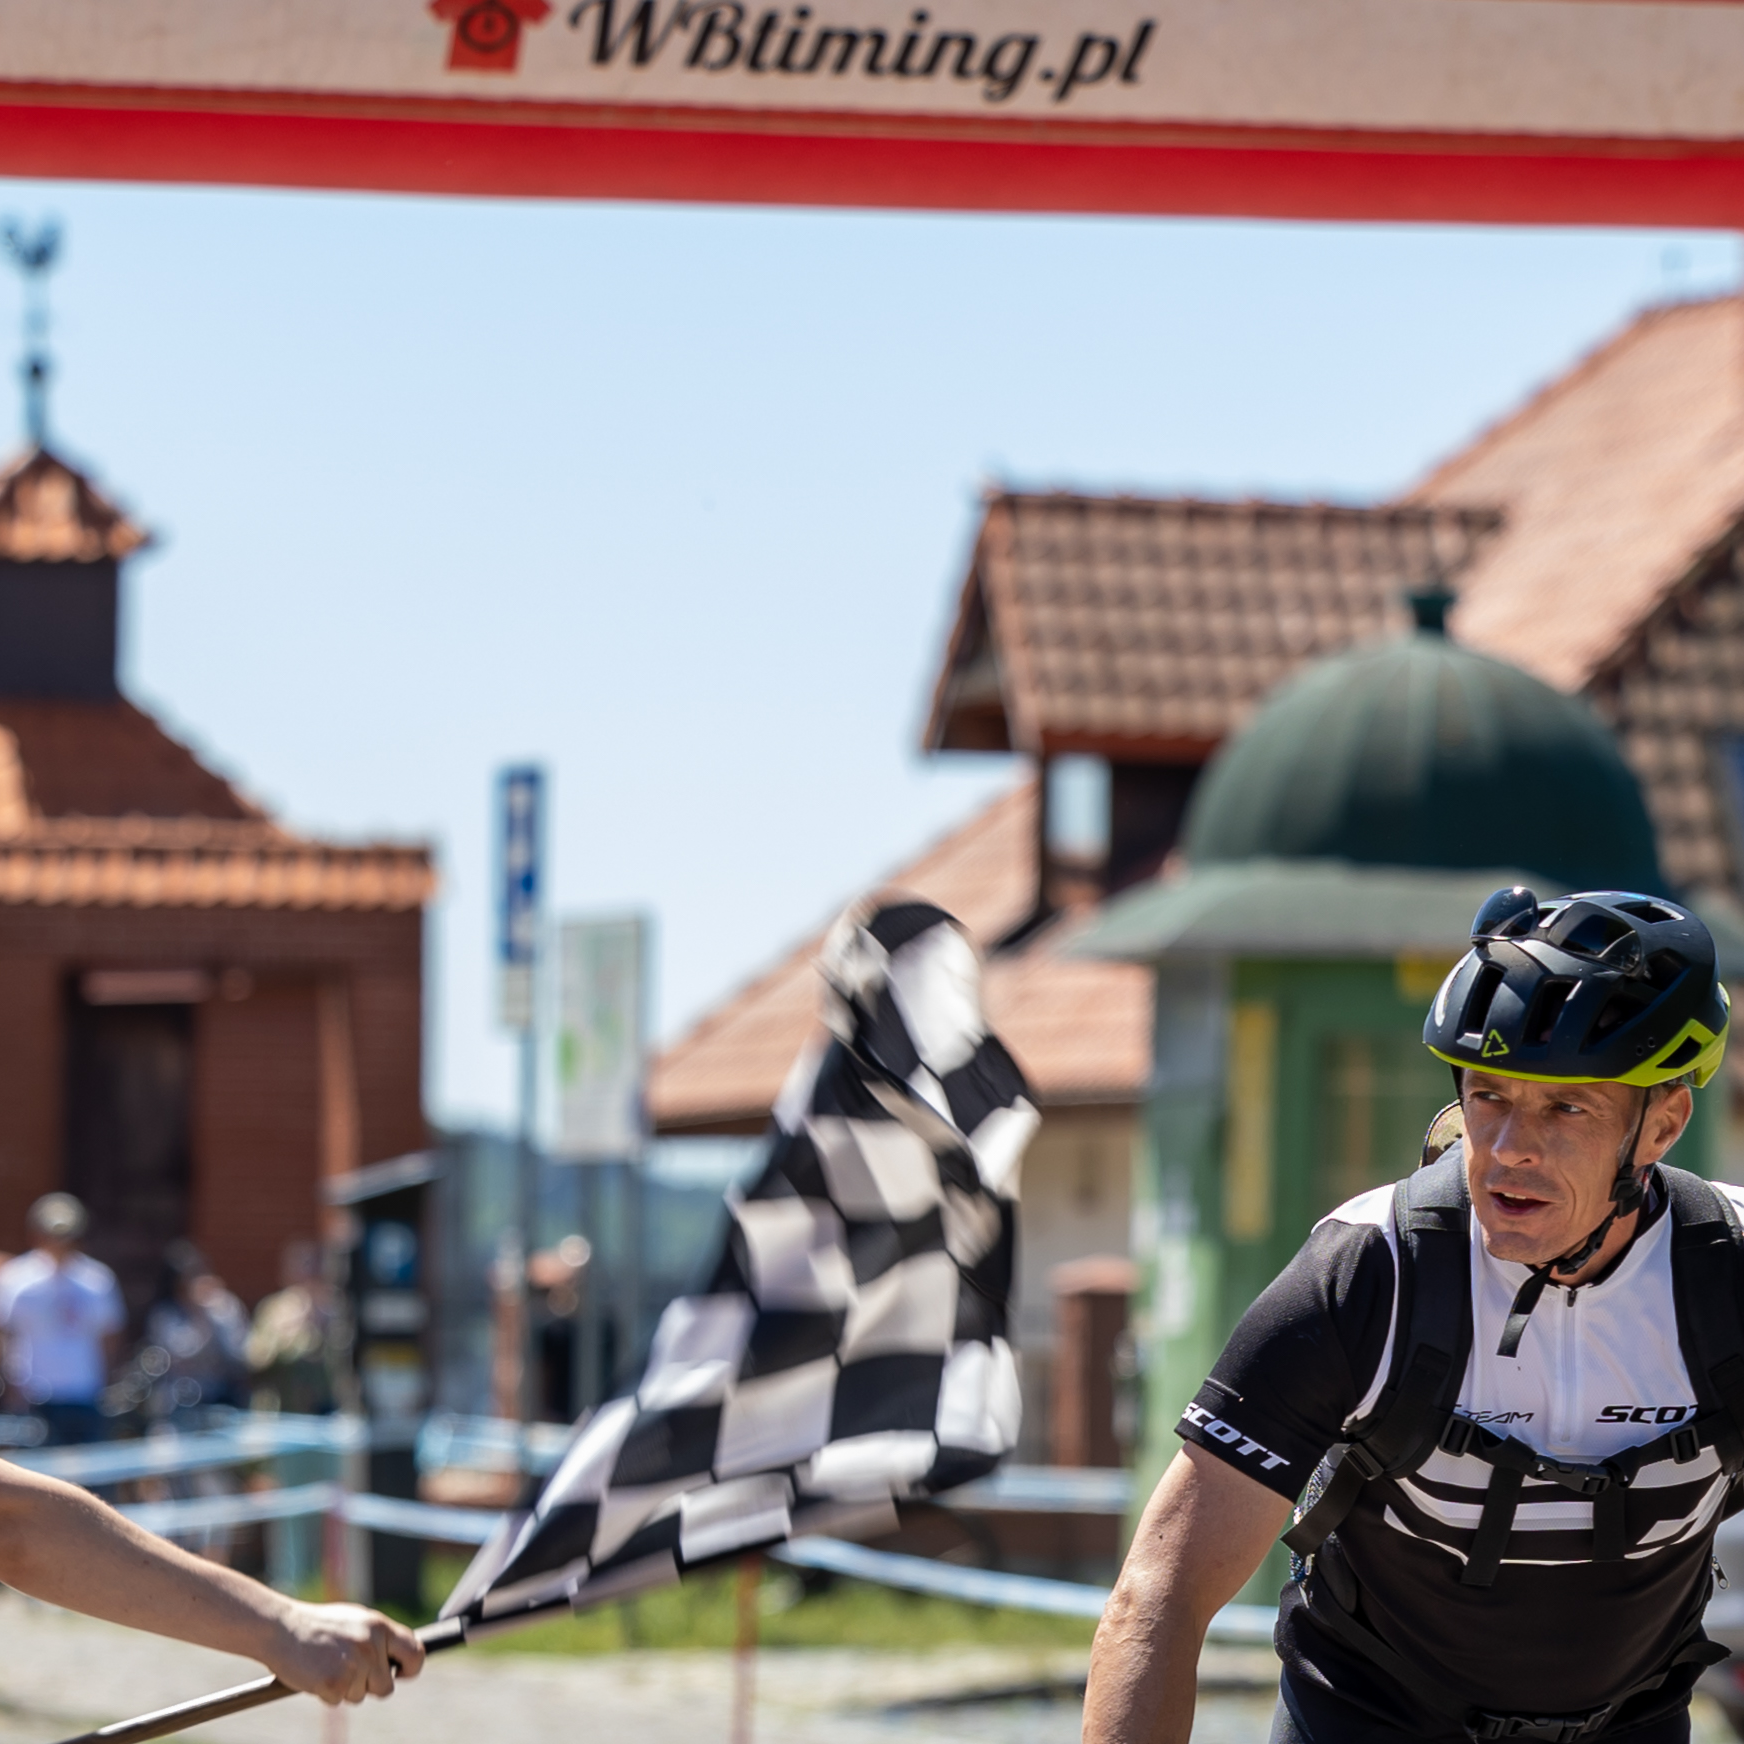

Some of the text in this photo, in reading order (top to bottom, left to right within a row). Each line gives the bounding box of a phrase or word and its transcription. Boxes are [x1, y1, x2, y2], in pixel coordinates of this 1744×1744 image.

[567, 0, 1158, 102] WBtiming.pl
[1181, 1401, 1291, 1470] SCOTT
[1463, 1410, 1535, 1424] TEAM
